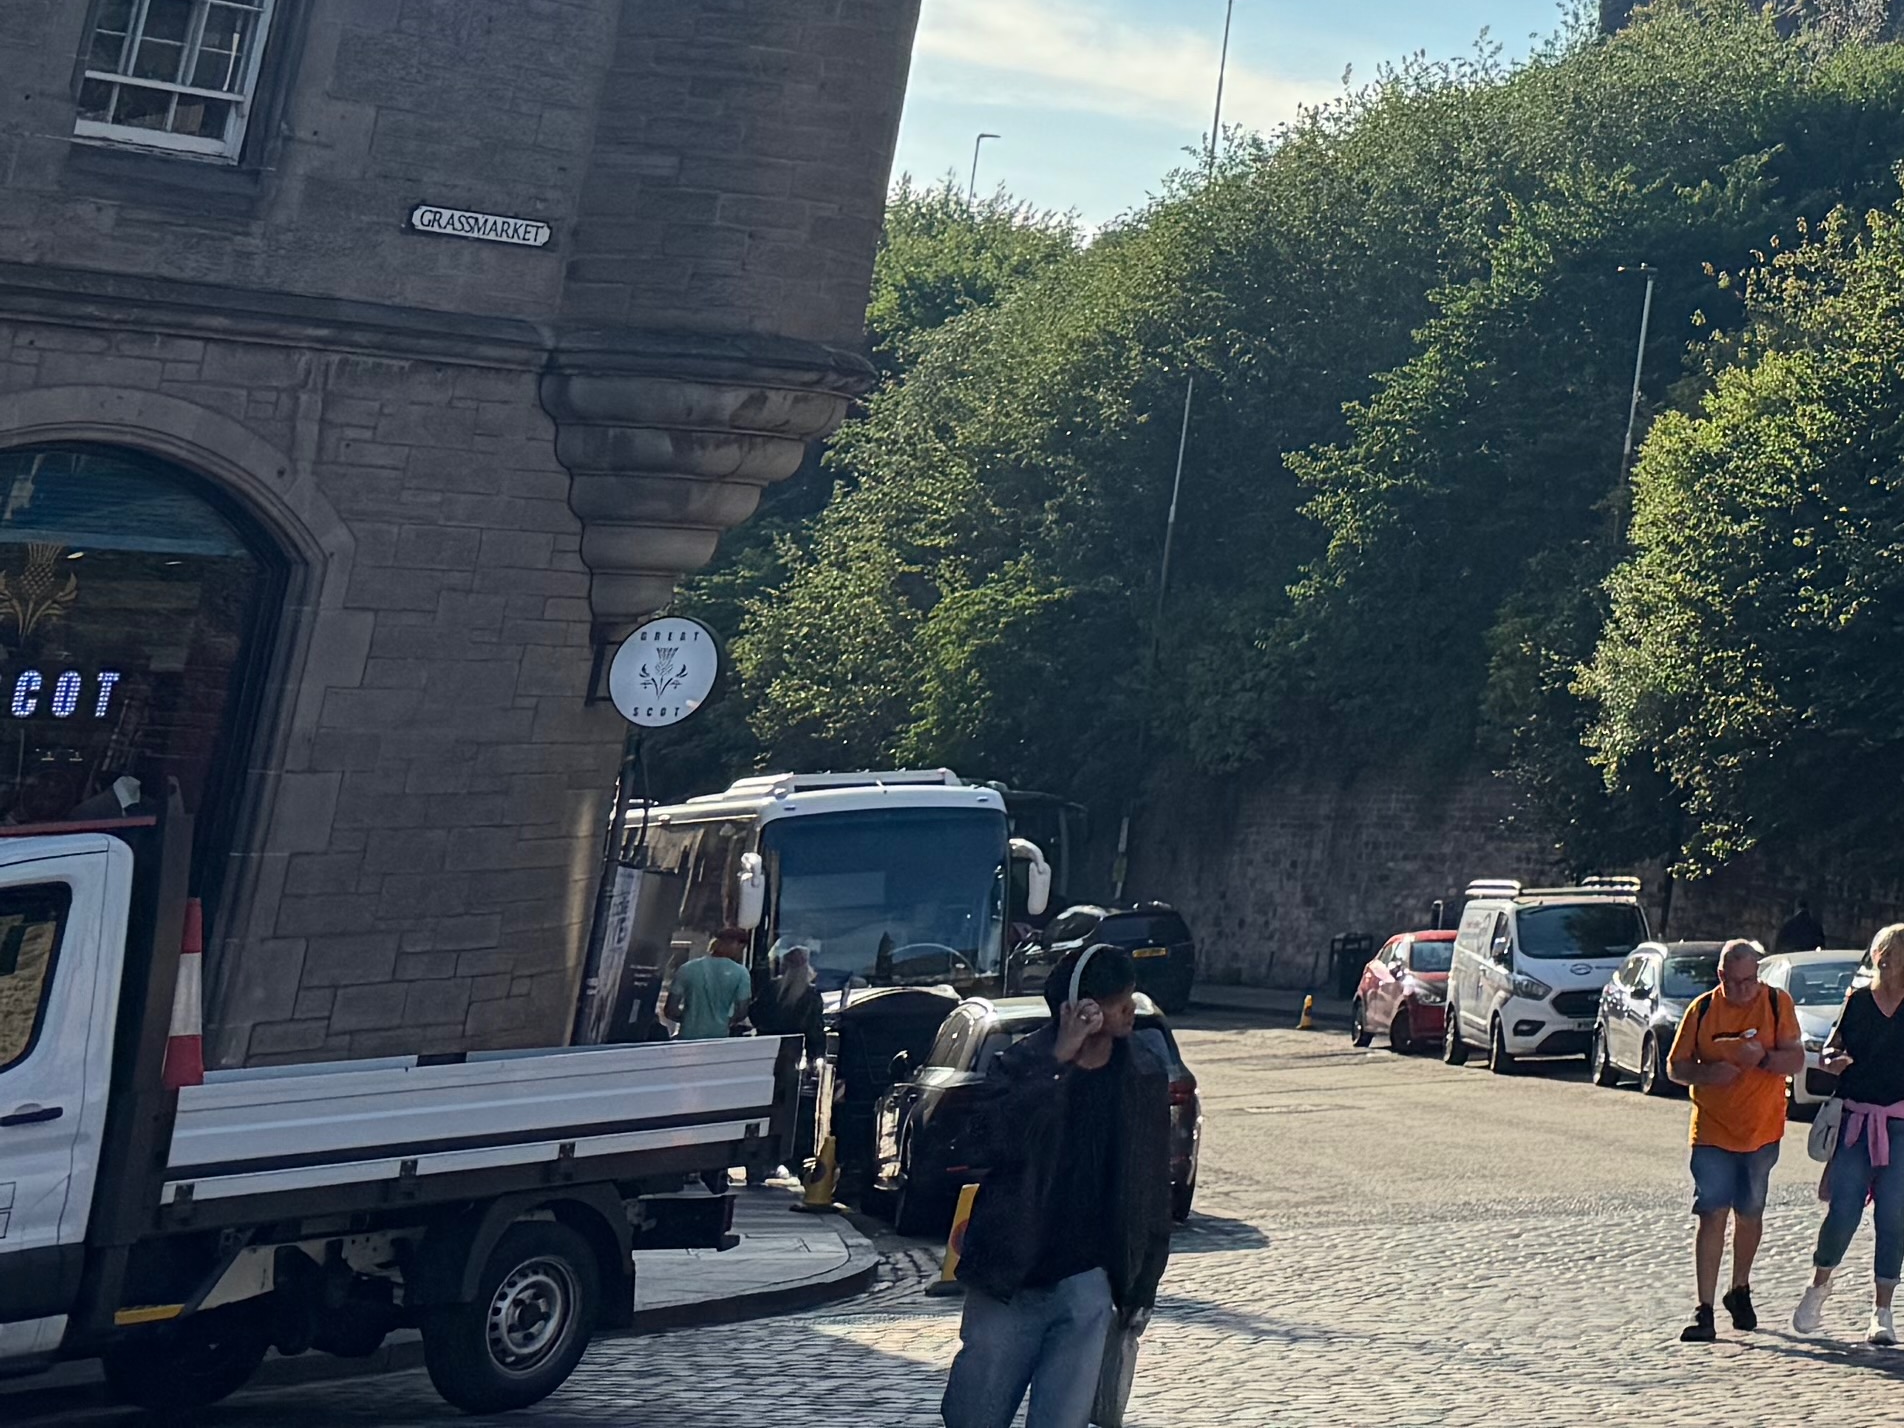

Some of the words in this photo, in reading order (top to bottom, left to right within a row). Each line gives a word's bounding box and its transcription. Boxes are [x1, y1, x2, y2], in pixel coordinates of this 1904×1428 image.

[420, 209, 545, 242] GRASSMARKET
[640, 631, 700, 642] GREAT
[0, 670, 121, 718] COT
[633, 707, 680, 717] SCOT
